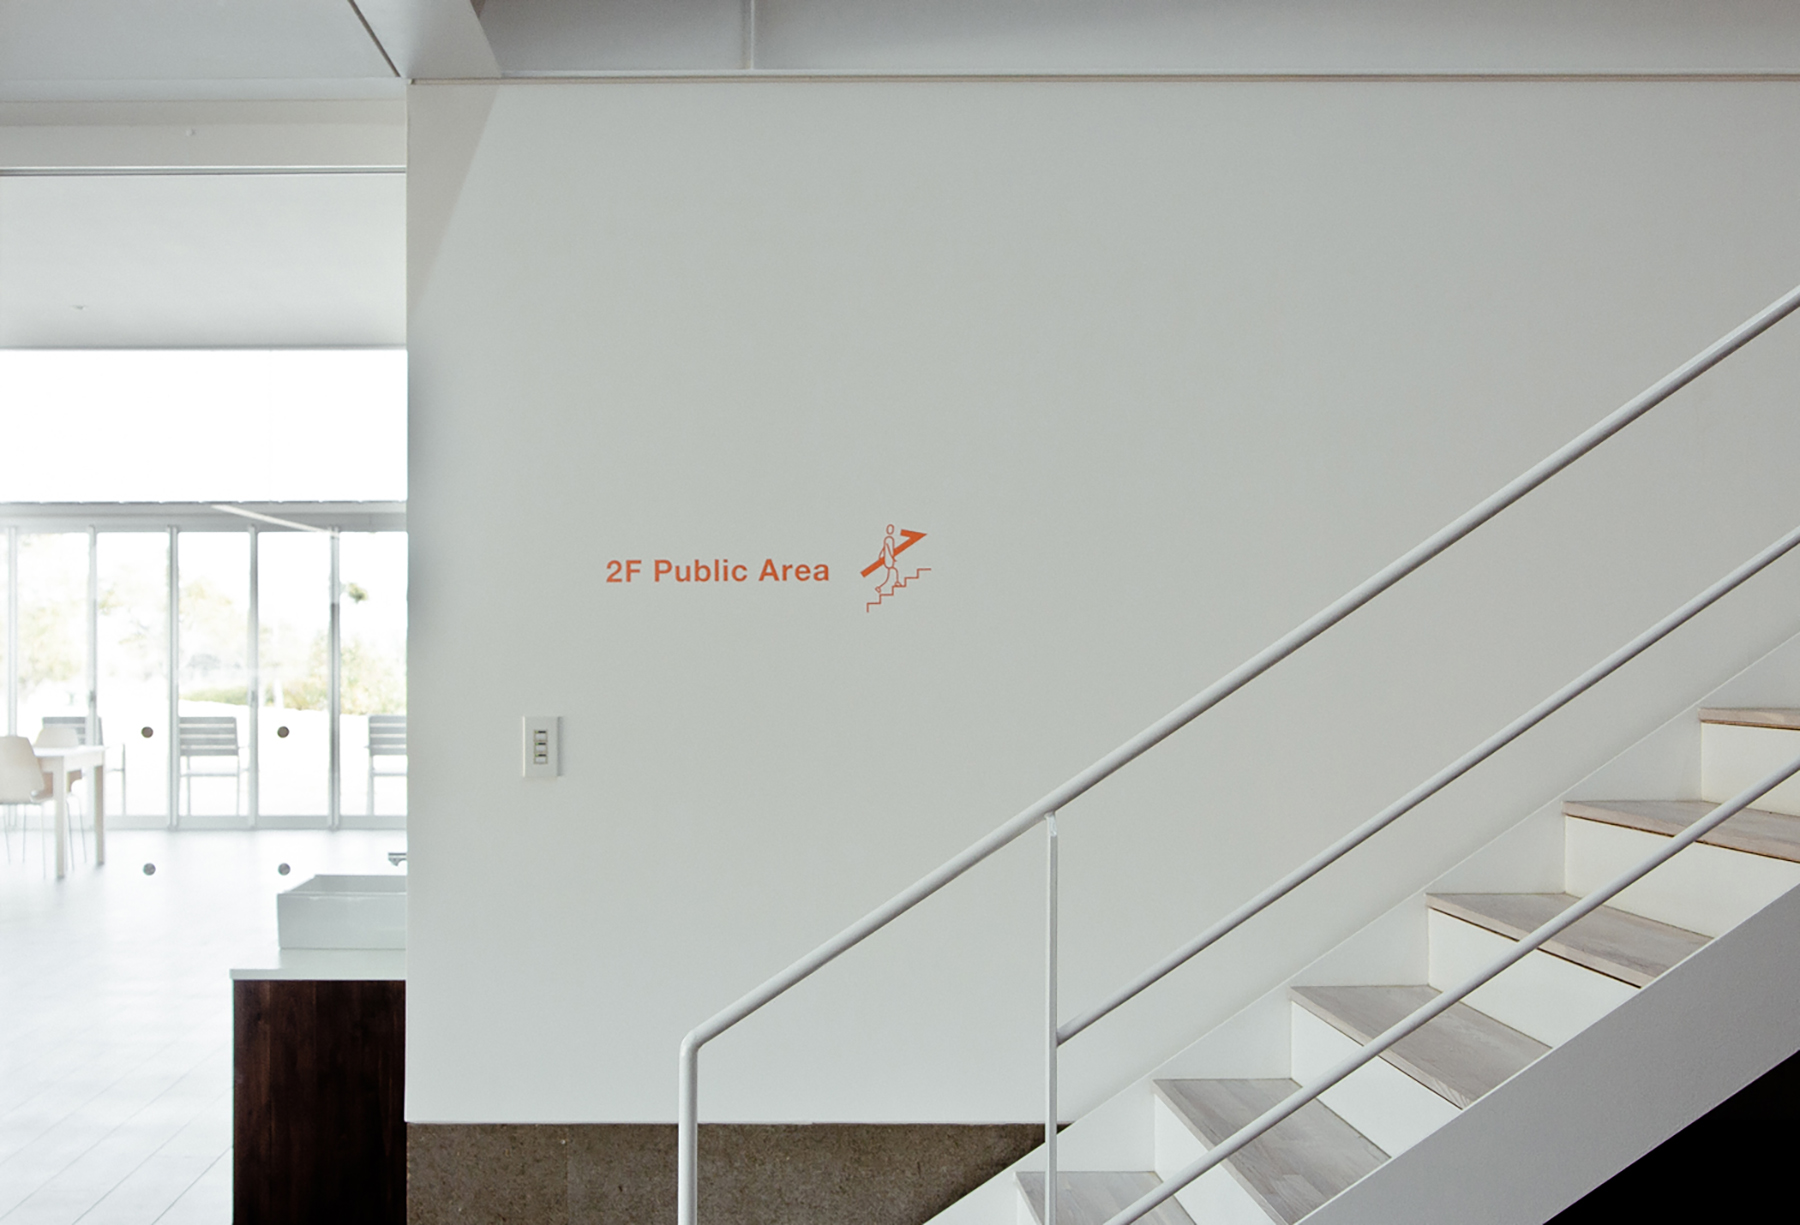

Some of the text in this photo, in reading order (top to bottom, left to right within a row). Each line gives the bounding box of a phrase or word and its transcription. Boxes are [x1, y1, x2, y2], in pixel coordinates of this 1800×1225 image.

[606, 558, 829, 583] 2F Public Area
